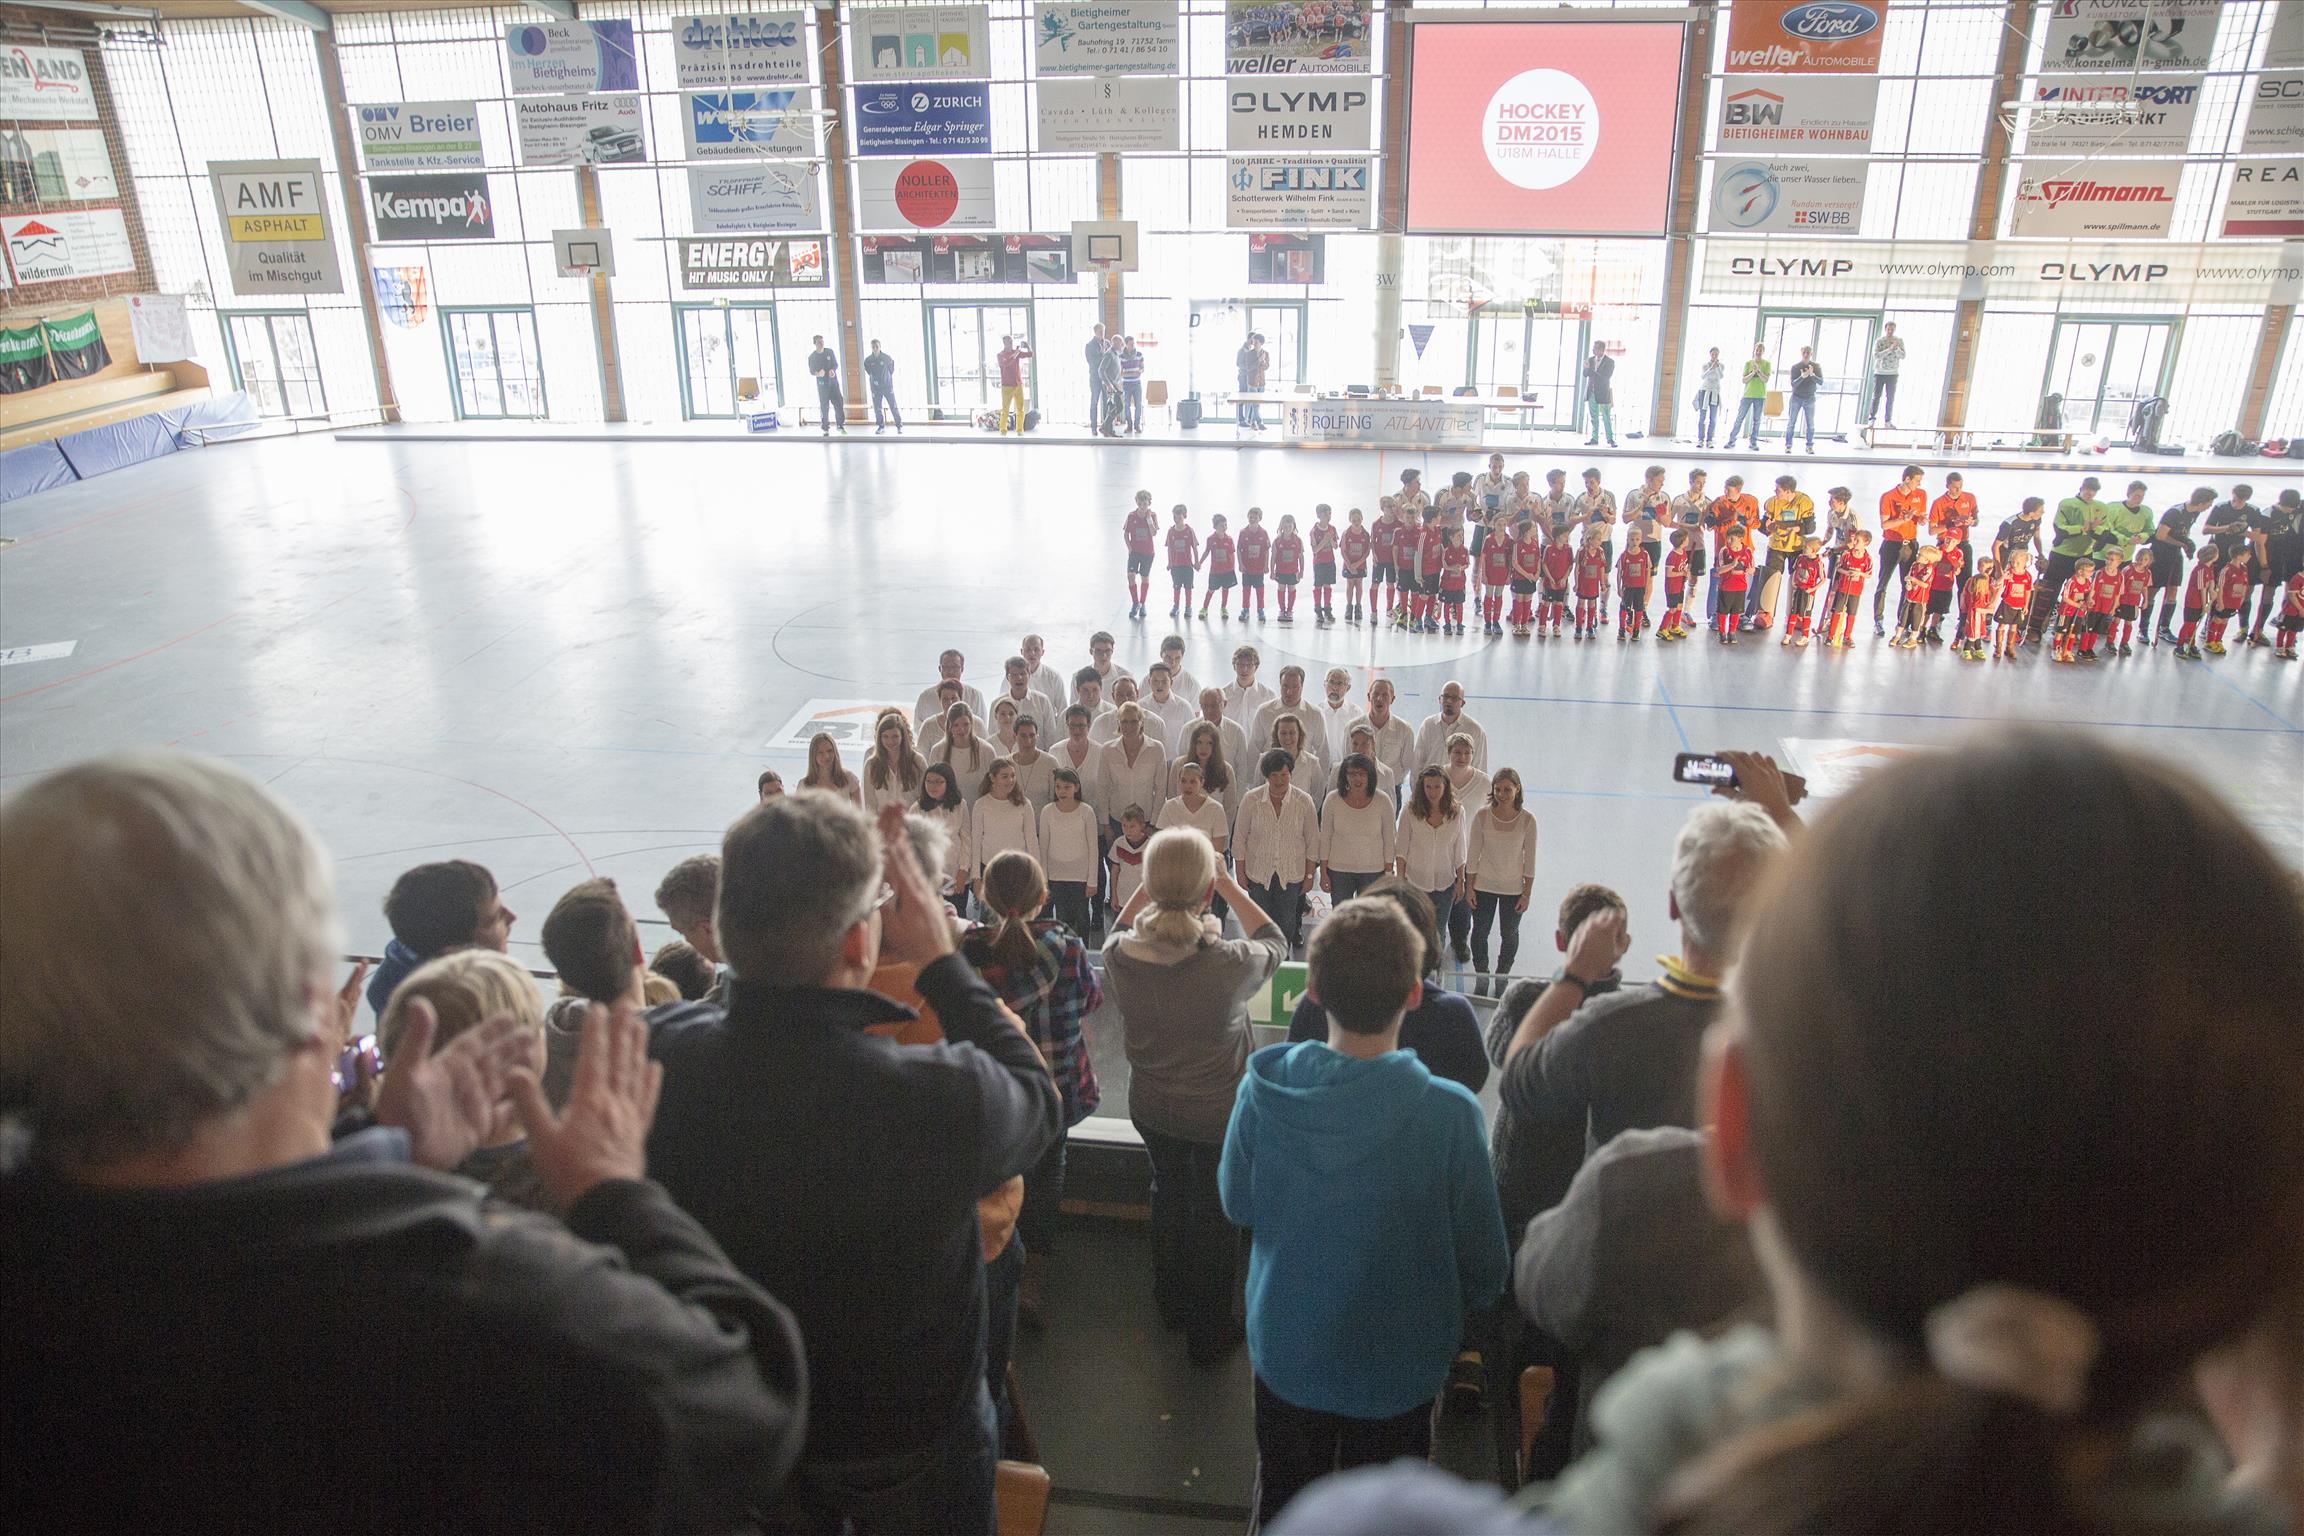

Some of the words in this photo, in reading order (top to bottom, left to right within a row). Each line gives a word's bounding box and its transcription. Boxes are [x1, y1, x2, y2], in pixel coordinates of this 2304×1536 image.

[1070, 8, 1131, 20] Bietigheimer
[1798, 6, 1861, 34] Ford
[548, 28, 570, 38] Beck
[681, 16, 798, 50] drehtec
[1078, 20, 1162, 32] Gartengestaltung
[1078, 38, 1114, 47] Bauhofring
[1156, 37, 1176, 45] Tamm
[1730, 45, 1804, 67] weller
[1802, 55, 1876, 67] AUTOMOBILE
[527, 58, 566, 71] Herzen
[1039, 61, 1177, 73] www.bietigheimer-gartengestaltung.de
[1227, 54, 1297, 74] weller
[1299, 62, 1371, 73] AUTOMOBILE
[533, 65, 597, 80] Bietigheims
[520, 103, 578, 114] Autohaus
[581, 101, 608, 112] Fritz
[1231, 92, 1367, 113] OLYMP
[1499, 104, 1586, 119] HOCKEY
[1725, 103, 1784, 126] BW
[410, 113, 474, 133] Breier
[863, 125, 912, 135] Generalagentur
[913, 120, 942, 136] Edgar
[943, 120, 985, 135] Springer
[365, 126, 402, 140] OMV
[1258, 124, 1332, 139] HEMDEN
[1498, 126, 1582, 141] DM2015
[1723, 127, 1805, 140] BIETIGHEIMER
[1808, 128, 1870, 141] WOHNBAU
[1282, 157, 1324, 165] Tradition
[1330, 156, 1367, 166] Qualität
[1497, 147, 1533, 159] U18M
[1537, 147, 1582, 160] HALLE
[370, 157, 415, 168] Tankstelle
[1768, 162, 1789, 172] Auch
[1790, 163, 1810, 173] zwei,
[901, 174, 951, 188] NOLLER
[1261, 167, 1366, 191] FINK
[1766, 175, 1779, 183] die
[1780, 175, 1802, 183] unser
[1804, 174, 1830, 184] Wasser
[237, 180, 304, 209] AMF
[706, 182, 763, 197] SCHIFF
[896, 189, 957, 200] ARCHITEKTEN
[2042, 181, 2174, 210] Spillmann
[1231, 194, 1283, 203] Schotterwerk
[1286, 194, 1316, 203] Wilhelm
[1318, 194, 1335, 203] Fink
[1791, 199, 1823, 209] Rundum
[373, 192, 467, 225] Kempa
[244, 218, 307, 233] ASPHALT
[2083, 222, 2161, 231] www.spillmann.de
[257, 250, 307, 265] Qualität
[688, 240, 782, 269] ENERGY
[18, 263, 75, 282] wildermuth
[249, 269, 264, 281] im
[266, 268, 323, 284] Mischgut
[1731, 257, 1854, 277] OLYMP
[1879, 260, 2016, 279] www.olymp.com
[2040, 262, 2169, 282] OLYMP
[688, 271, 706, 284] HIT
[707, 271, 741, 284] MUSIC
[741, 271, 770, 284] ONLY
[1311, 415, 1372, 431] ROLFING
